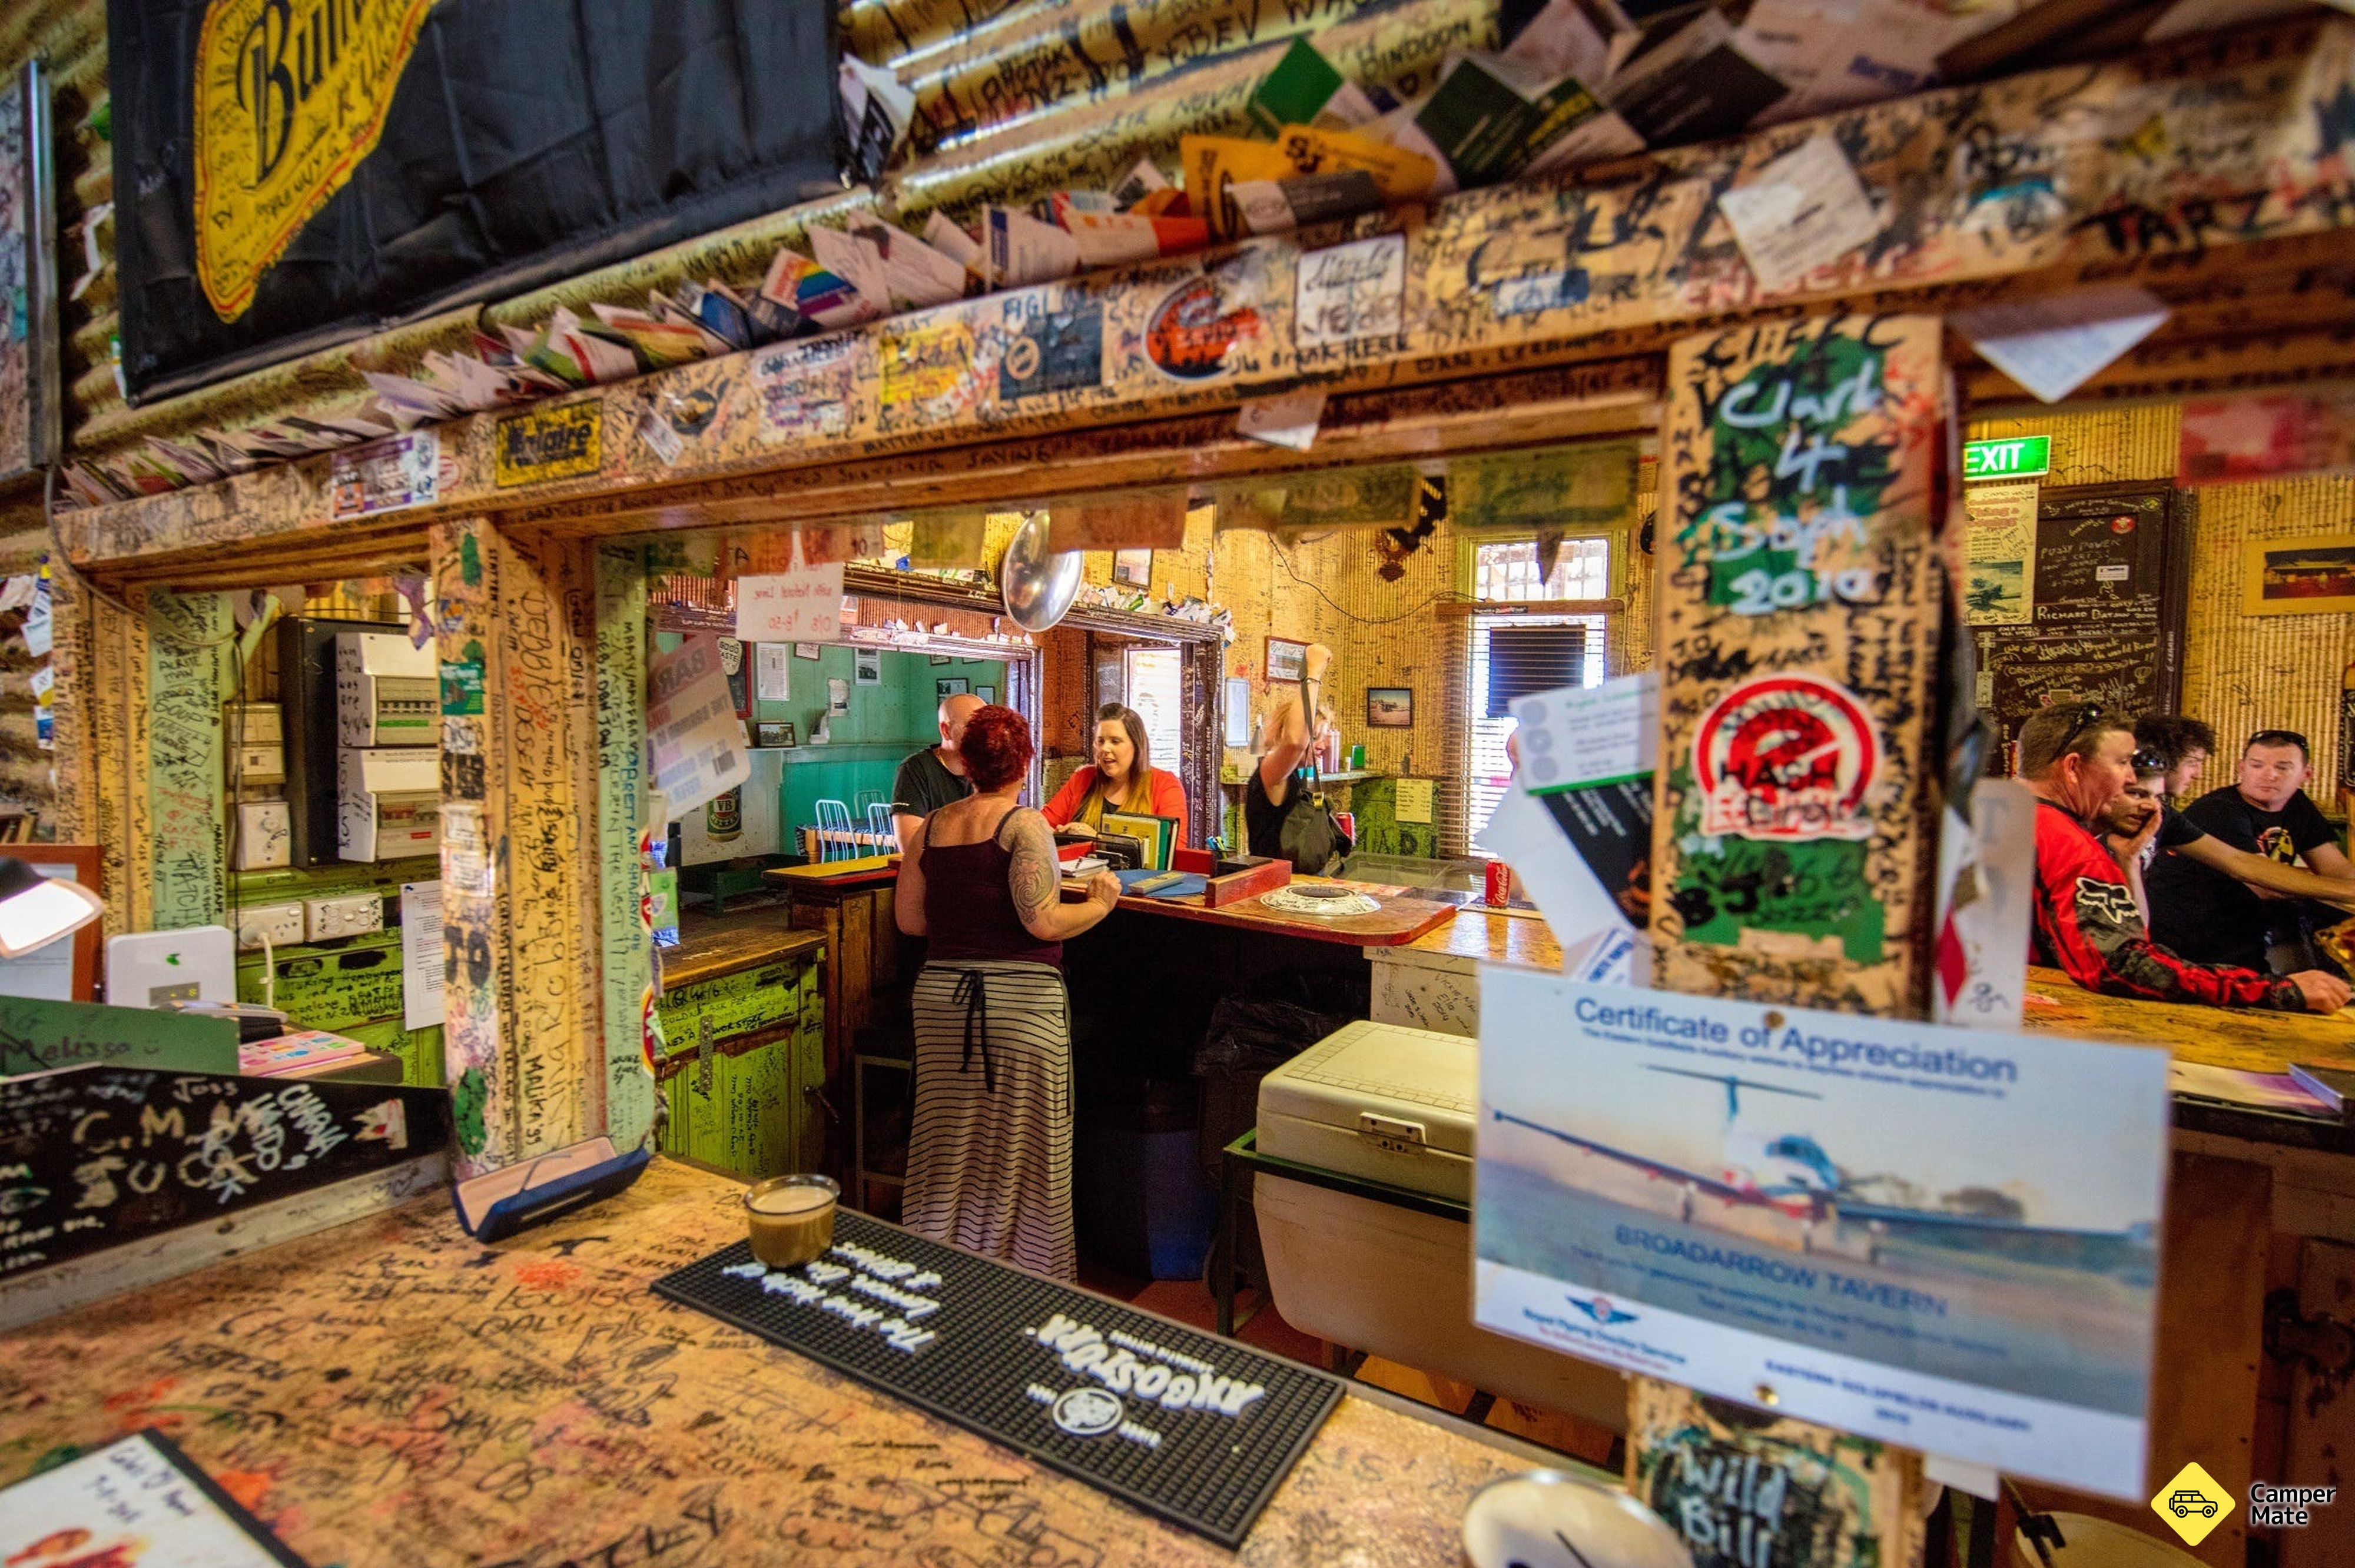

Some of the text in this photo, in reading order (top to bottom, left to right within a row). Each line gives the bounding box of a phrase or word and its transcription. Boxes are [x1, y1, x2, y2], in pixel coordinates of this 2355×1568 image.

[1963, 443, 2025, 473] EXIT
[2037, 606, 2088, 620] RICHARD
[720, 651, 738, 663] ASTE
[717, 799, 733, 812] VB
[214, 823, 224, 863] MARCUS
[626, 826, 640, 855] AND
[1574, 996, 1730, 1044] Certificate
[1739, 1022, 1773, 1049] of
[1780, 1026, 2018, 1083] Appreciation
[1614, 1223, 1818, 1290] BROADARROW
[1037, 1313, 1265, 1416] ANGOSTURA
